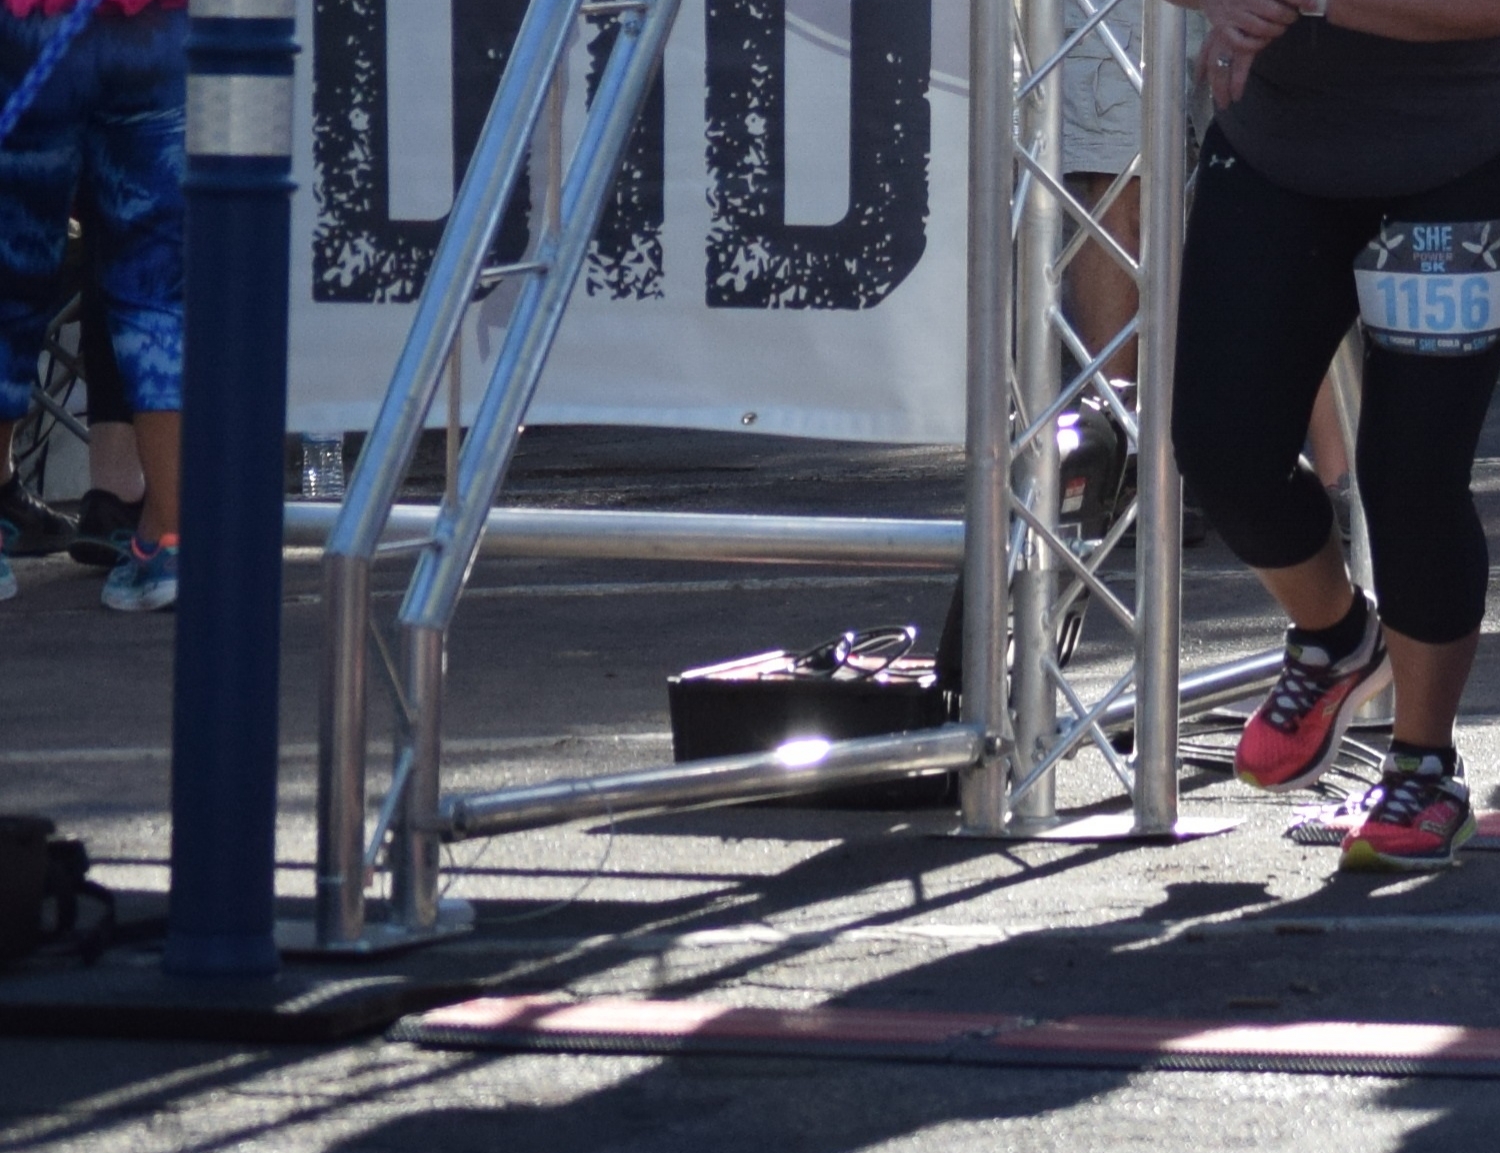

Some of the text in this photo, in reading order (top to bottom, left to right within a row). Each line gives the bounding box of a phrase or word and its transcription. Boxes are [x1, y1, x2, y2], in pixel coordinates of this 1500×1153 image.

[1413, 226, 1453, 252] SHE
[1420, 262, 1445, 272] 5K
[1376, 276, 1491, 331] 1156
[1419, 339, 1437, 352] SHE
